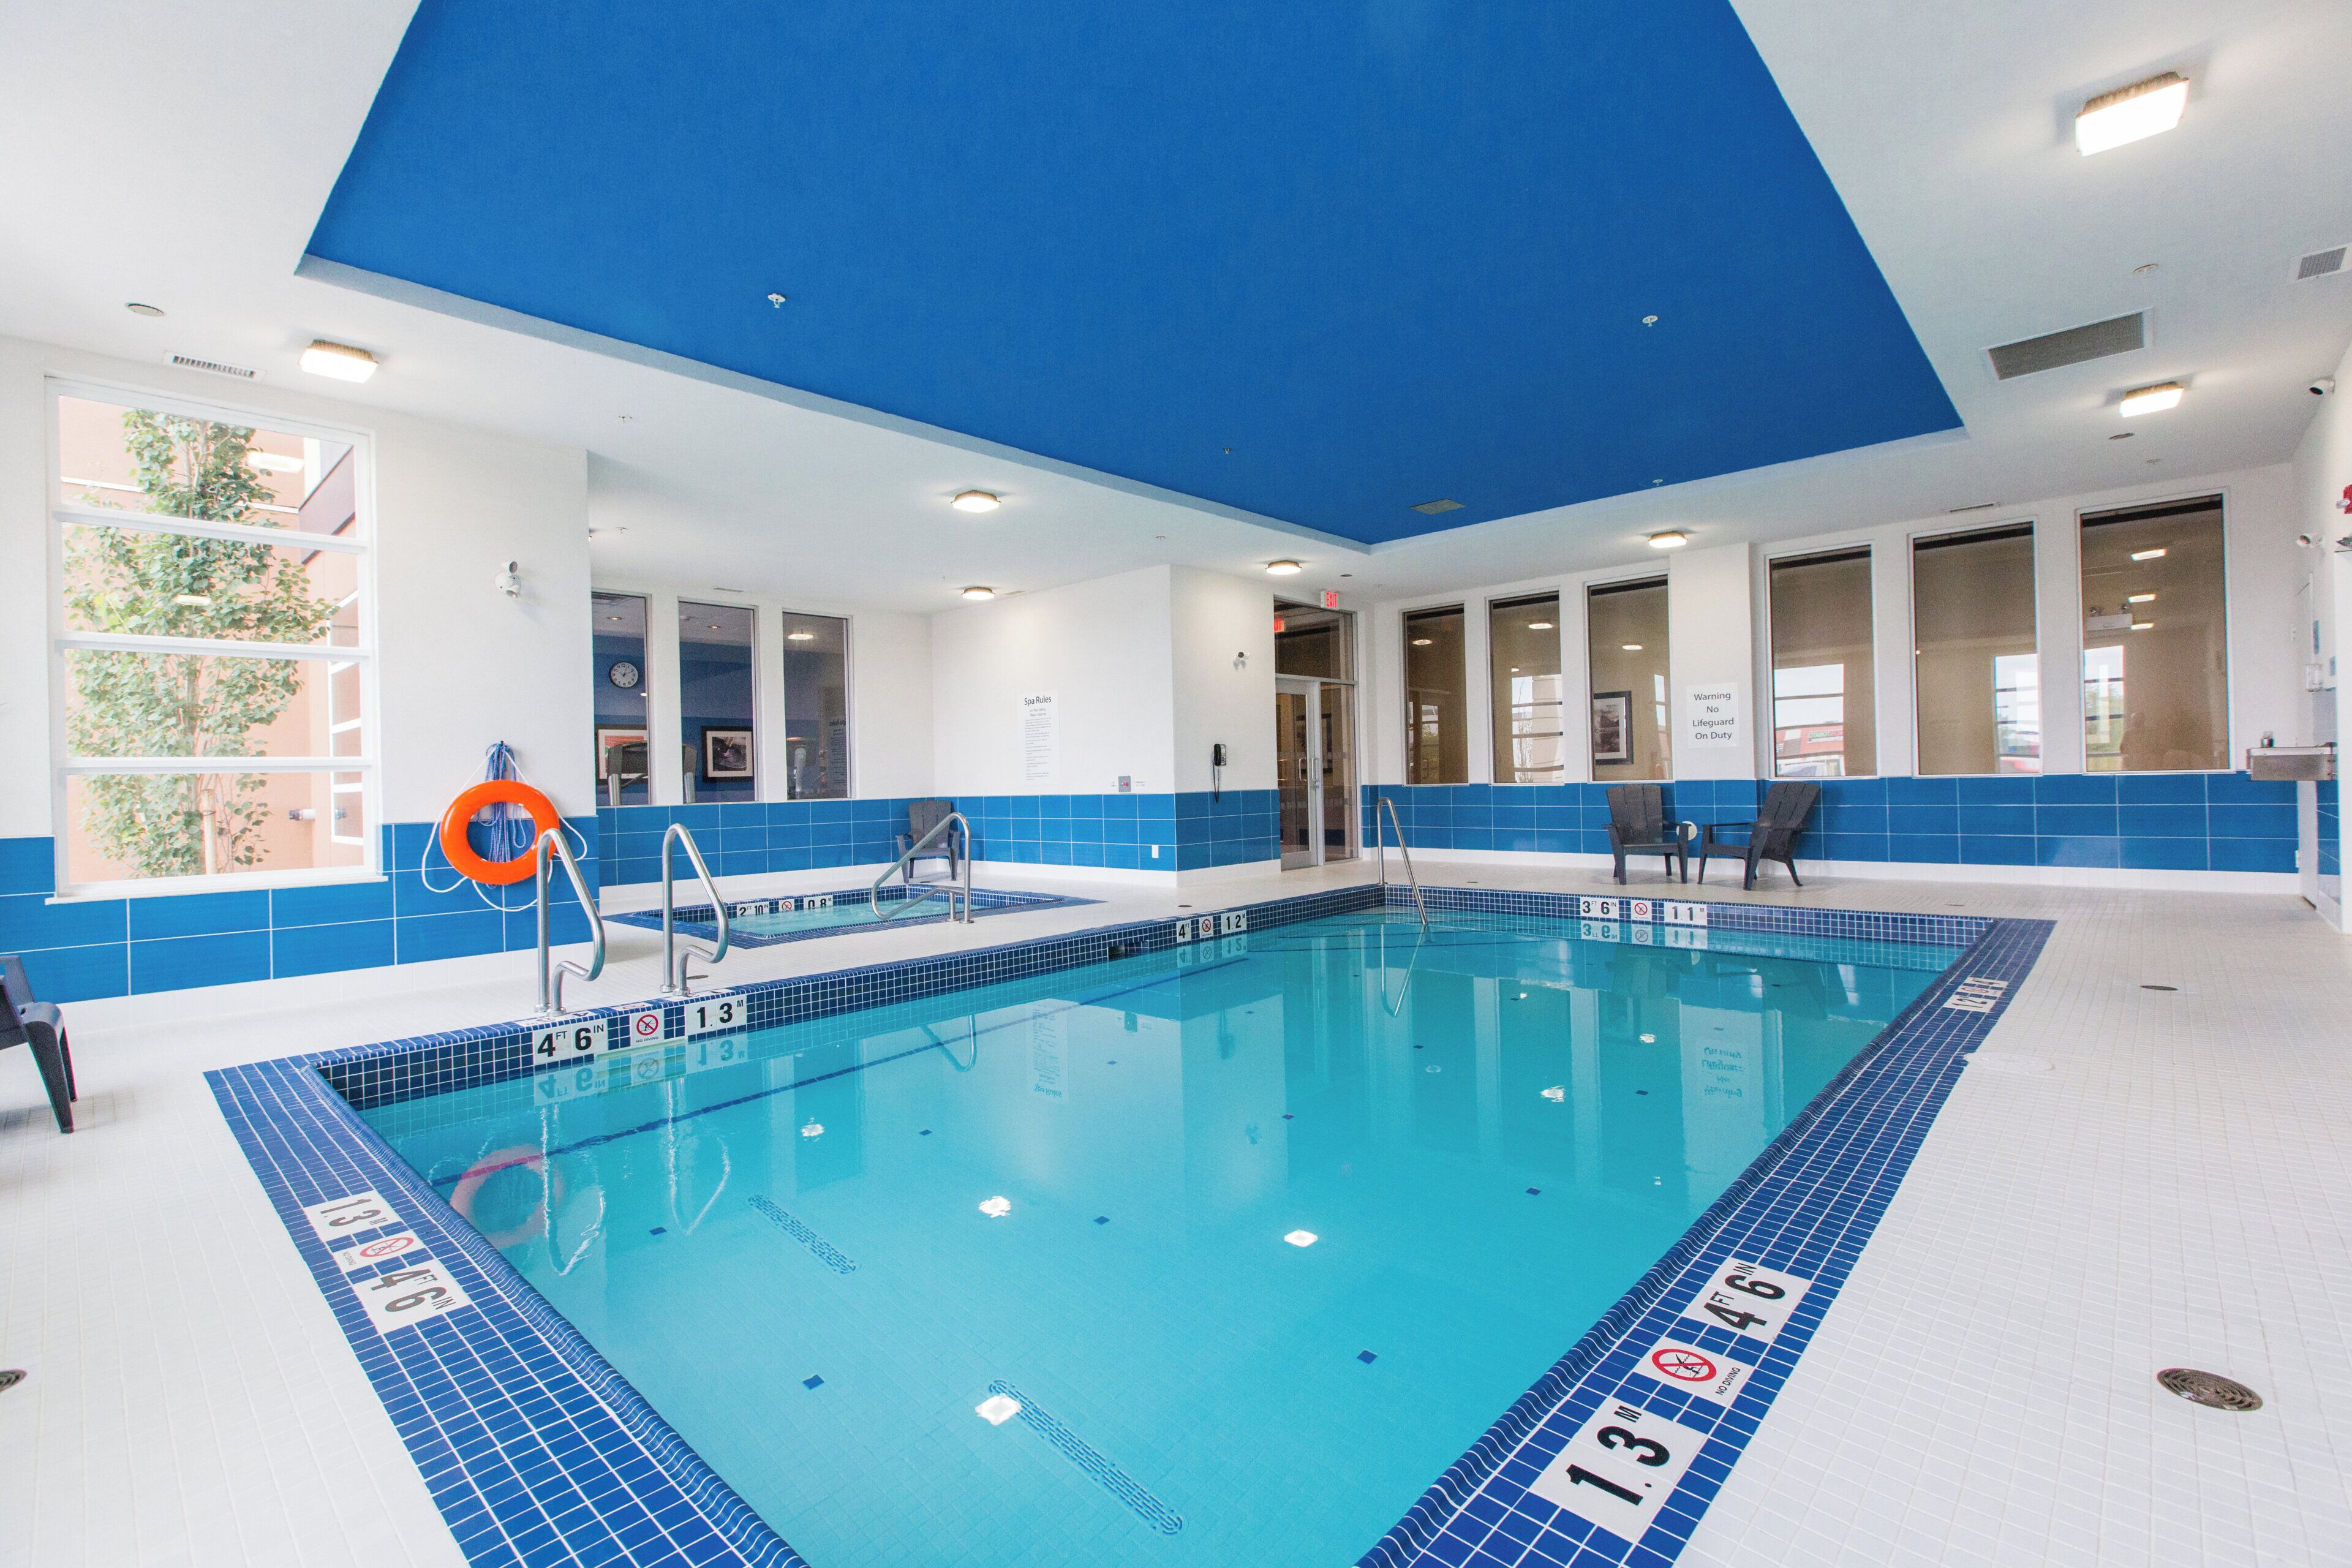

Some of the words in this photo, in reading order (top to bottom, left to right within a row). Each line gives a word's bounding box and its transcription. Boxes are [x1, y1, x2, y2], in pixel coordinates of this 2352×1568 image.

[1326, 592, 1338, 608] EXIT
[1024, 698, 1035, 707] Spa
[1036, 695, 1052, 704] Rules
[1692, 718, 1734, 728] Lifeguard
[739, 907, 747, 916] 2
[1582, 900, 1591, 914] 3
[1600, 902, 1610, 914] 6
[696, 1003, 733, 1028] 1.3
[537, 1033, 556, 1057] 4
[556, 1030, 567, 1039] FT
[575, 1027, 592, 1050] 6
[594, 1023, 604, 1033] IN
[320, 1199, 382, 1227] 1.3
[1733, 1262, 1757, 1276] IN
[371, 1269, 431, 1291] 4
[414, 1274, 437, 1286] FT
[1724, 1275, 1785, 1300] 6
[385, 1287, 447, 1312] 6
[432, 1297, 456, 1310] IN
[1711, 1291, 1735, 1306] FT
[1703, 1302, 1767, 1330] 4
[1715, 1385, 1727, 1395] NO
[1722, 1367, 1741, 1386] DIVING
[1613, 1406, 1642, 1423] M
[1566, 1426, 1670, 1506] 1.3
